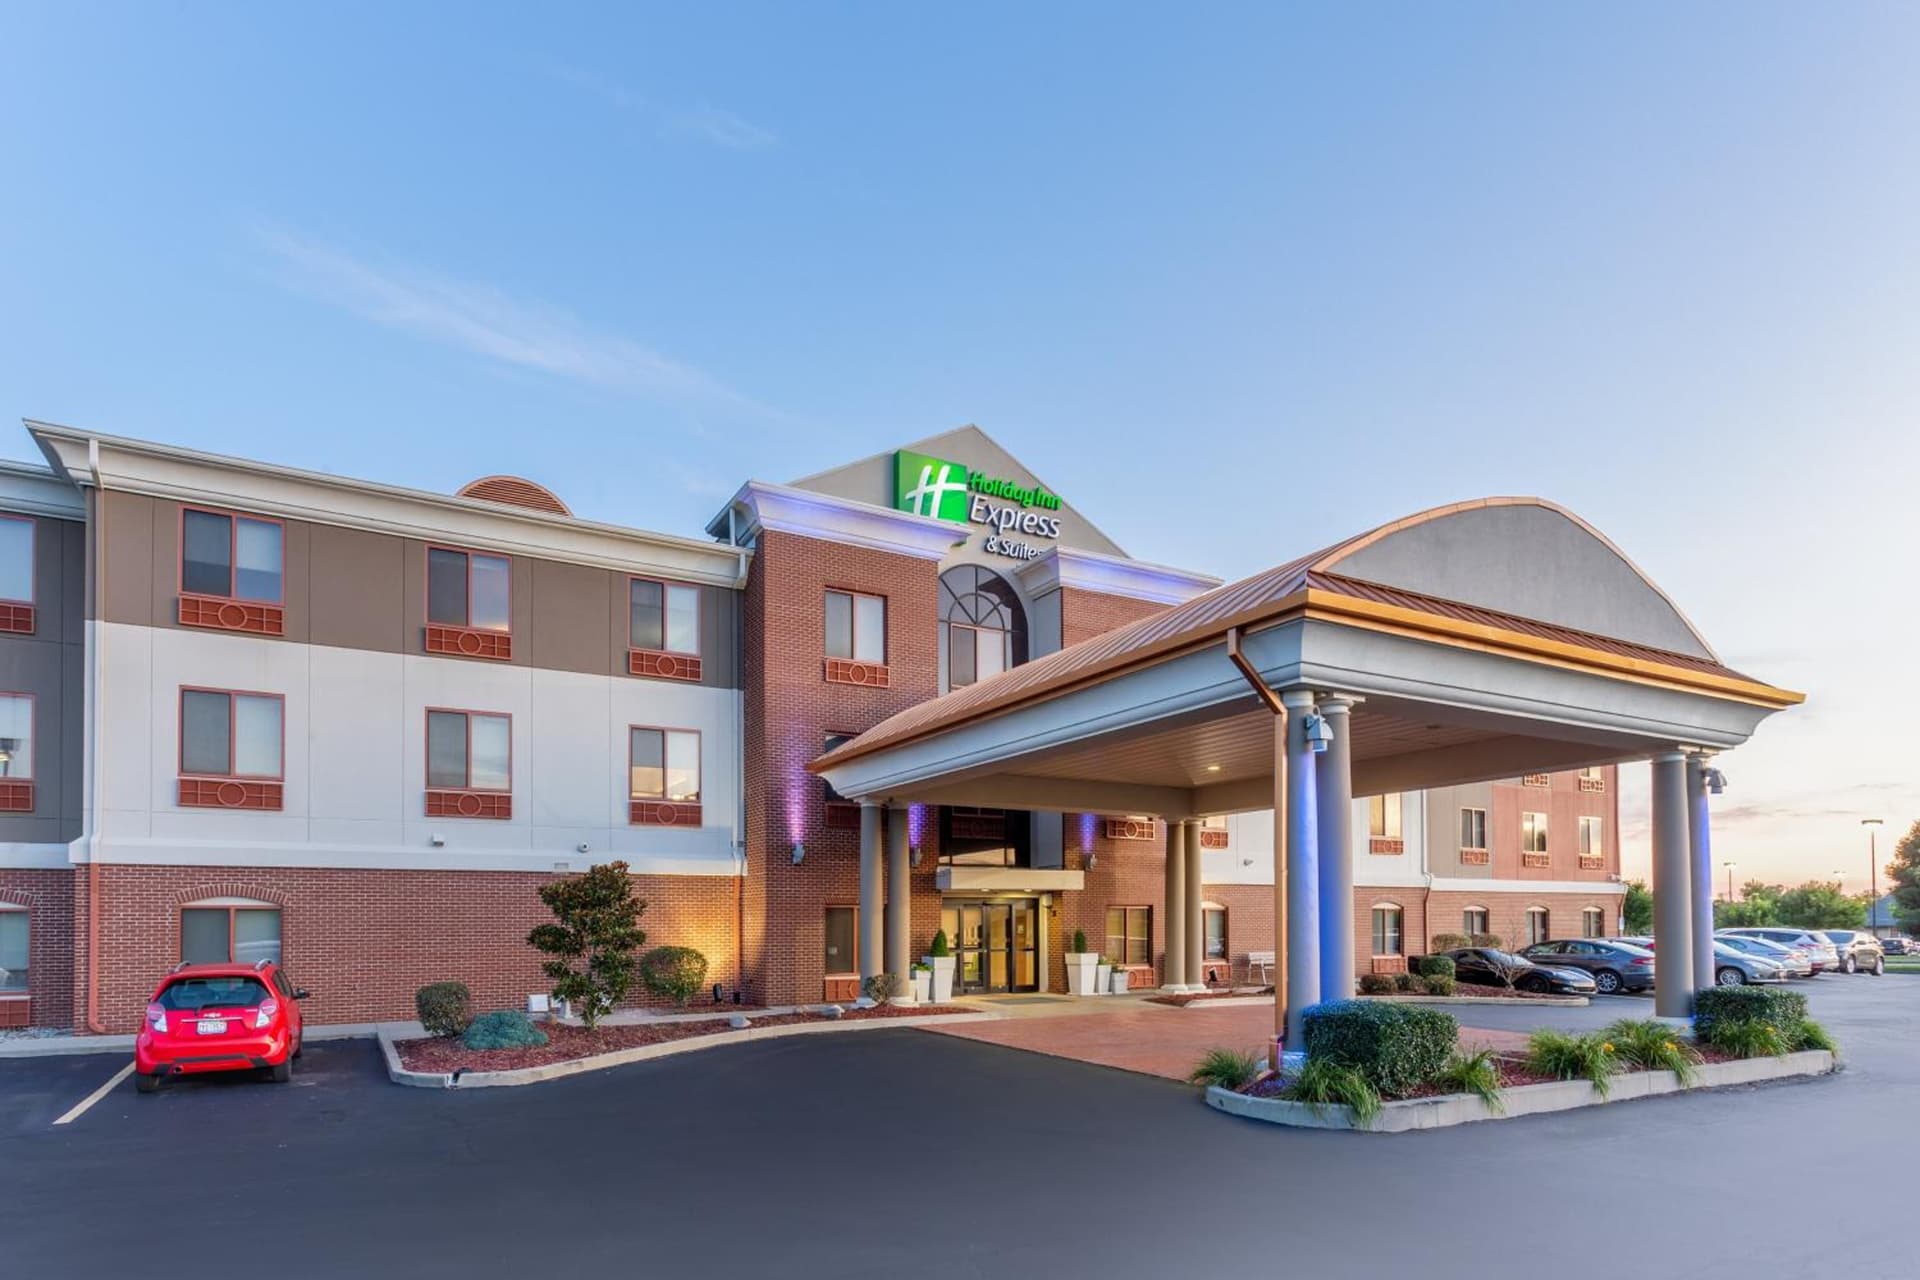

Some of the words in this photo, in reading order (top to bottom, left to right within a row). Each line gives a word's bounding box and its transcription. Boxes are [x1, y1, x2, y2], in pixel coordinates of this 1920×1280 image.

[970, 472, 1033, 507] Holiday
[1036, 486, 1062, 511] Inn
[970, 494, 1060, 538] Express
[986, 535, 999, 553] &
